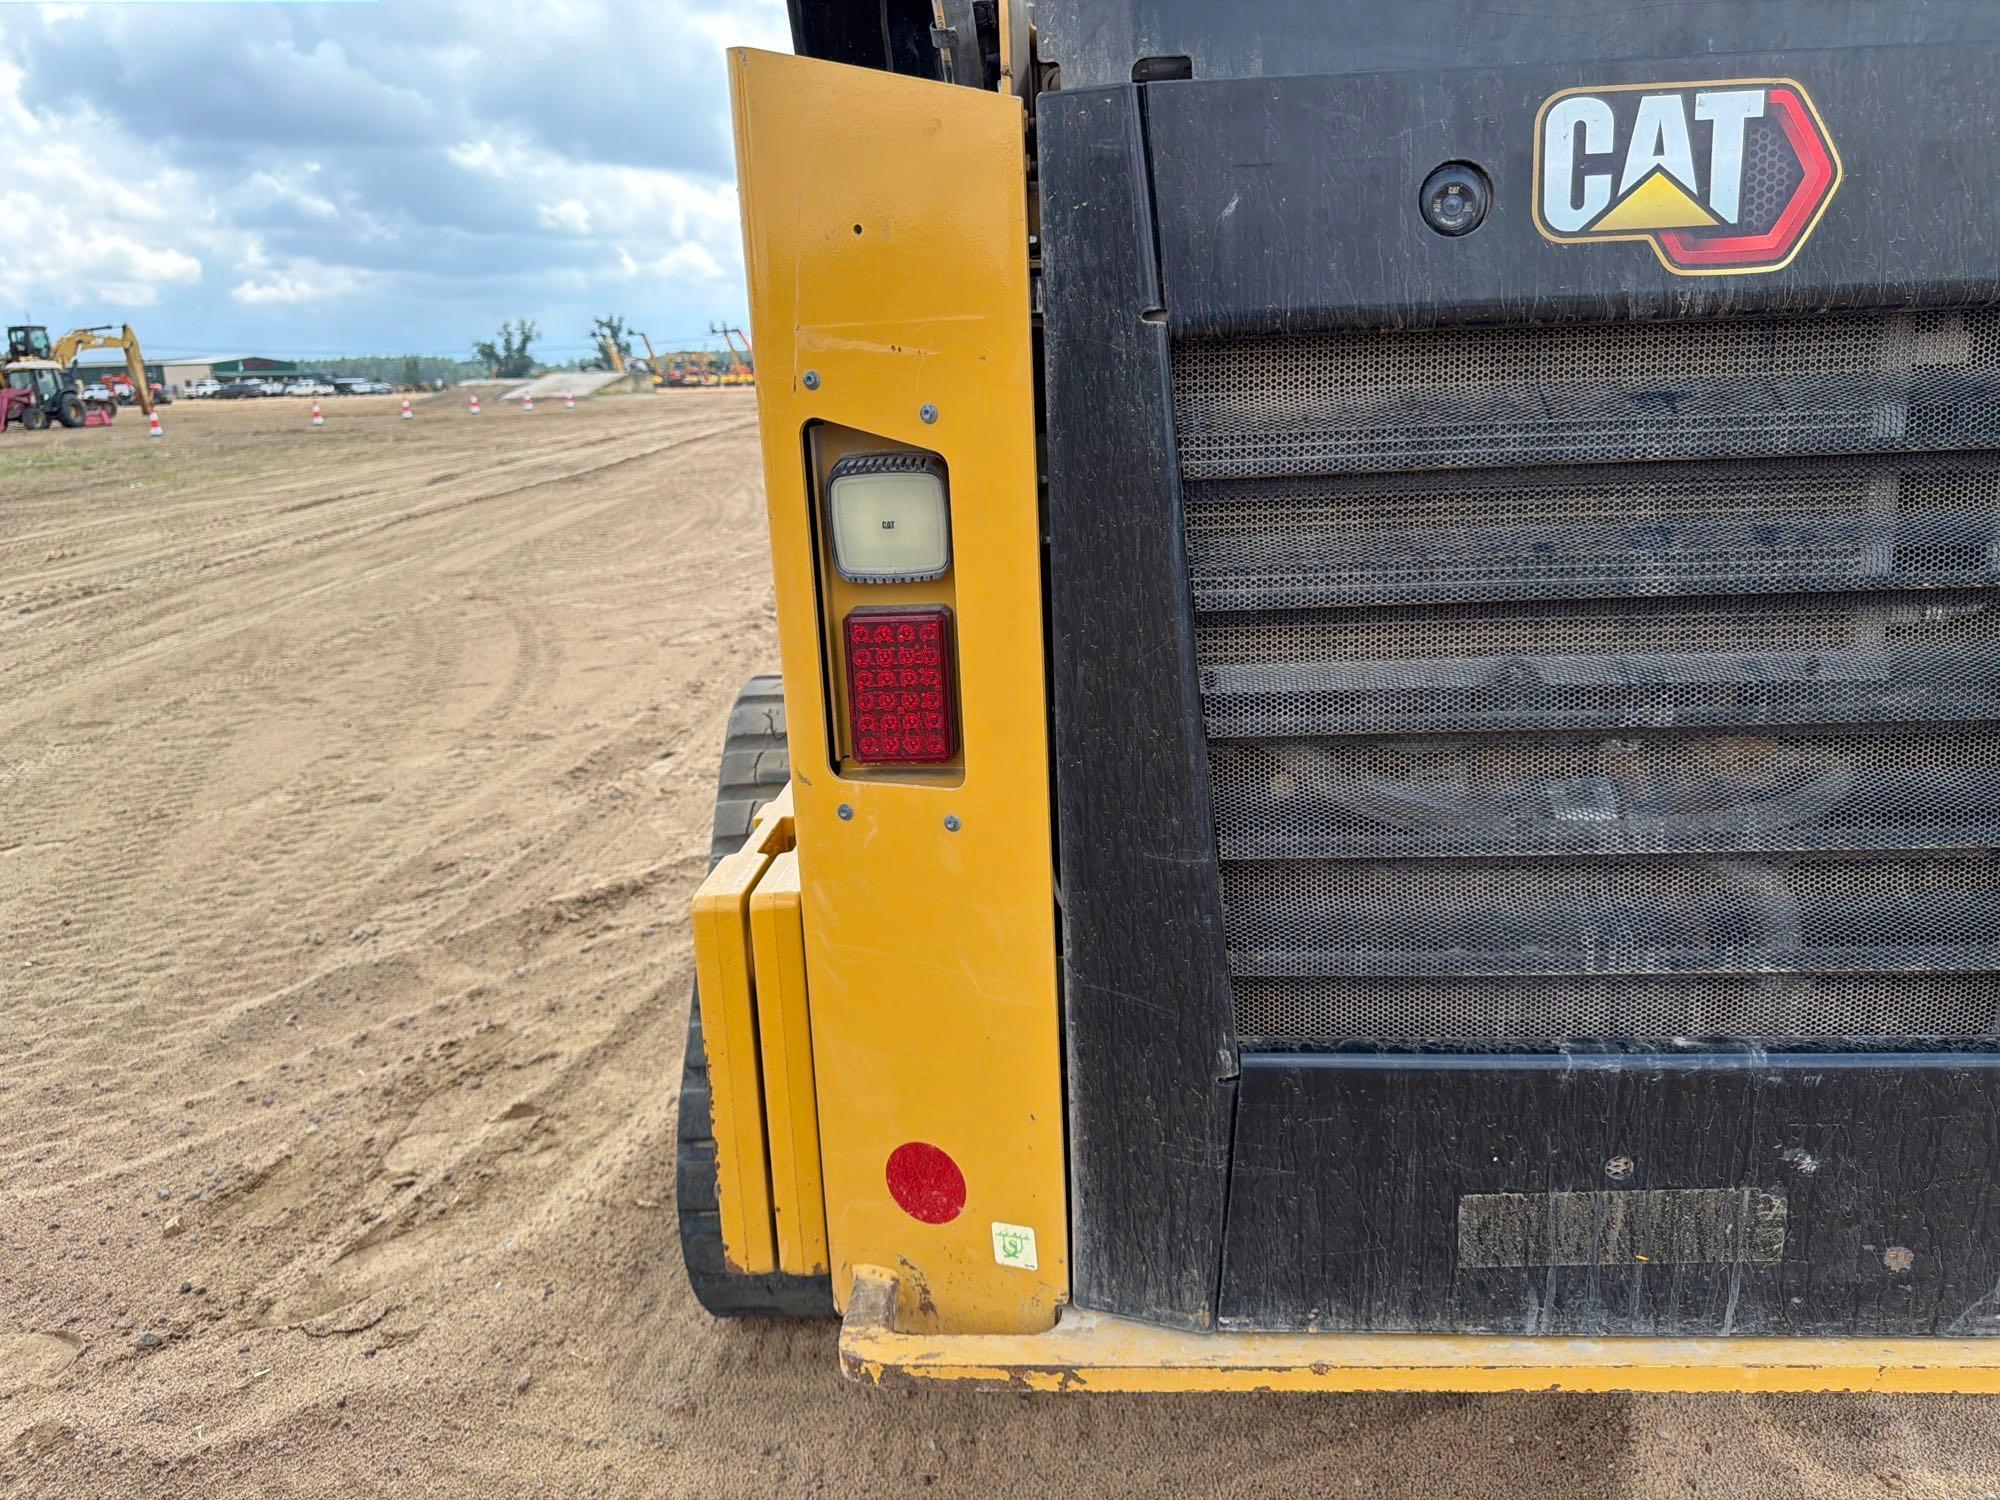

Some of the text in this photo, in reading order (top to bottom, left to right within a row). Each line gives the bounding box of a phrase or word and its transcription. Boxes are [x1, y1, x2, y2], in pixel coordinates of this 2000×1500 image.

[1543, 89, 1766, 232] CAT
[1448, 186, 1460, 194] CAT
[882, 521, 894, 529] CAT
